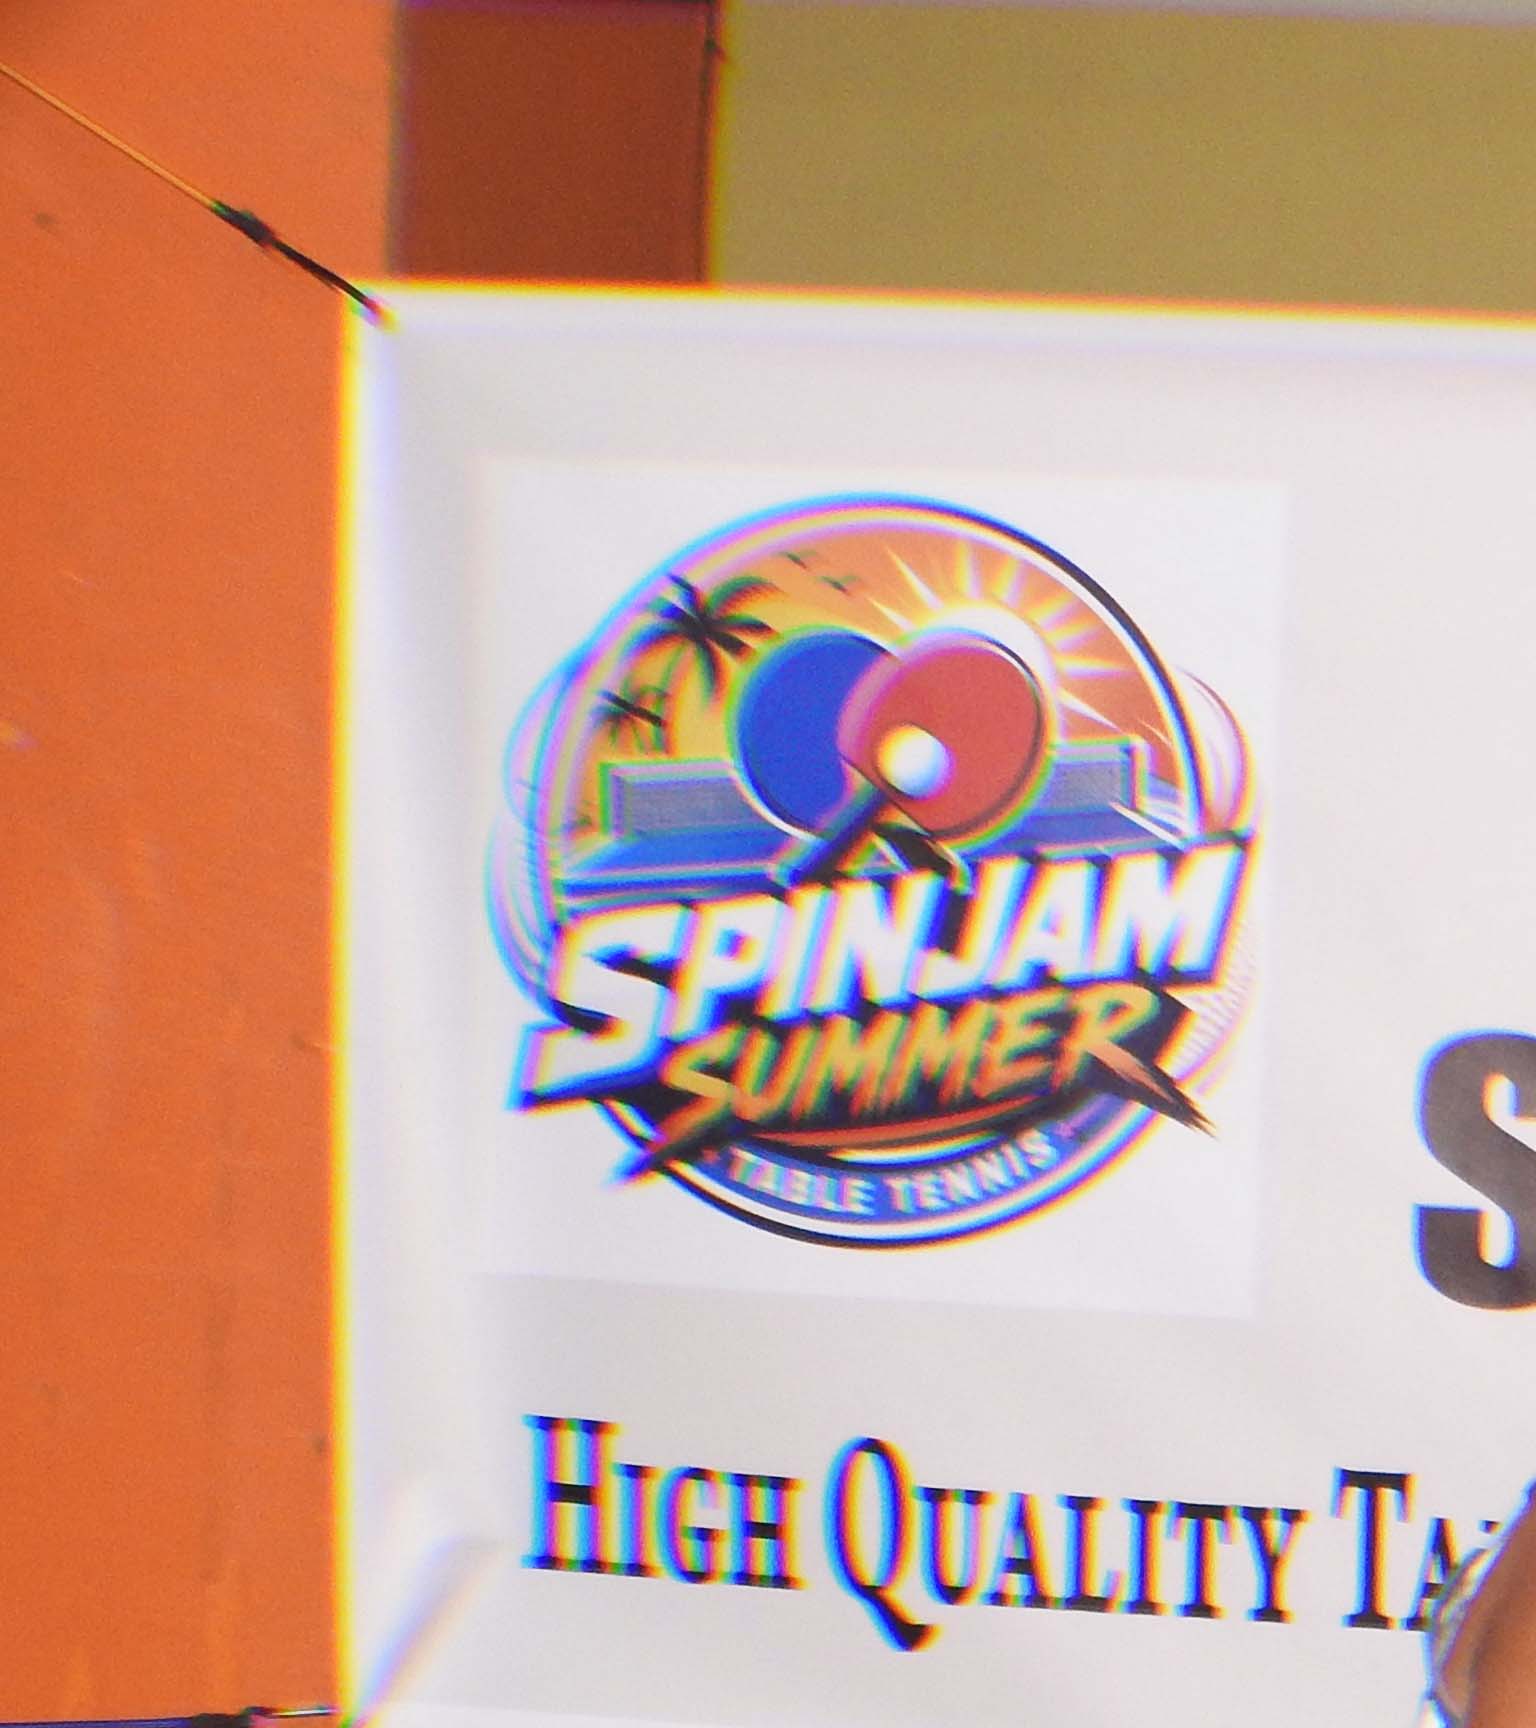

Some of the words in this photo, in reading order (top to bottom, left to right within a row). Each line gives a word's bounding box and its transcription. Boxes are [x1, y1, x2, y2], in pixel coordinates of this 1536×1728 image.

[506, 838, 1246, 1110] SPINJAM
[648, 980, 1205, 1165] SUMMER
[728, 1144, 875, 1215] TABLE
[884, 1126, 1059, 1214] TENNIS
[523, 1414, 804, 1590] HIGH
[824, 1435, 1309, 1652] QUALITY
[1331, 1466, 1500, 1632] TA
